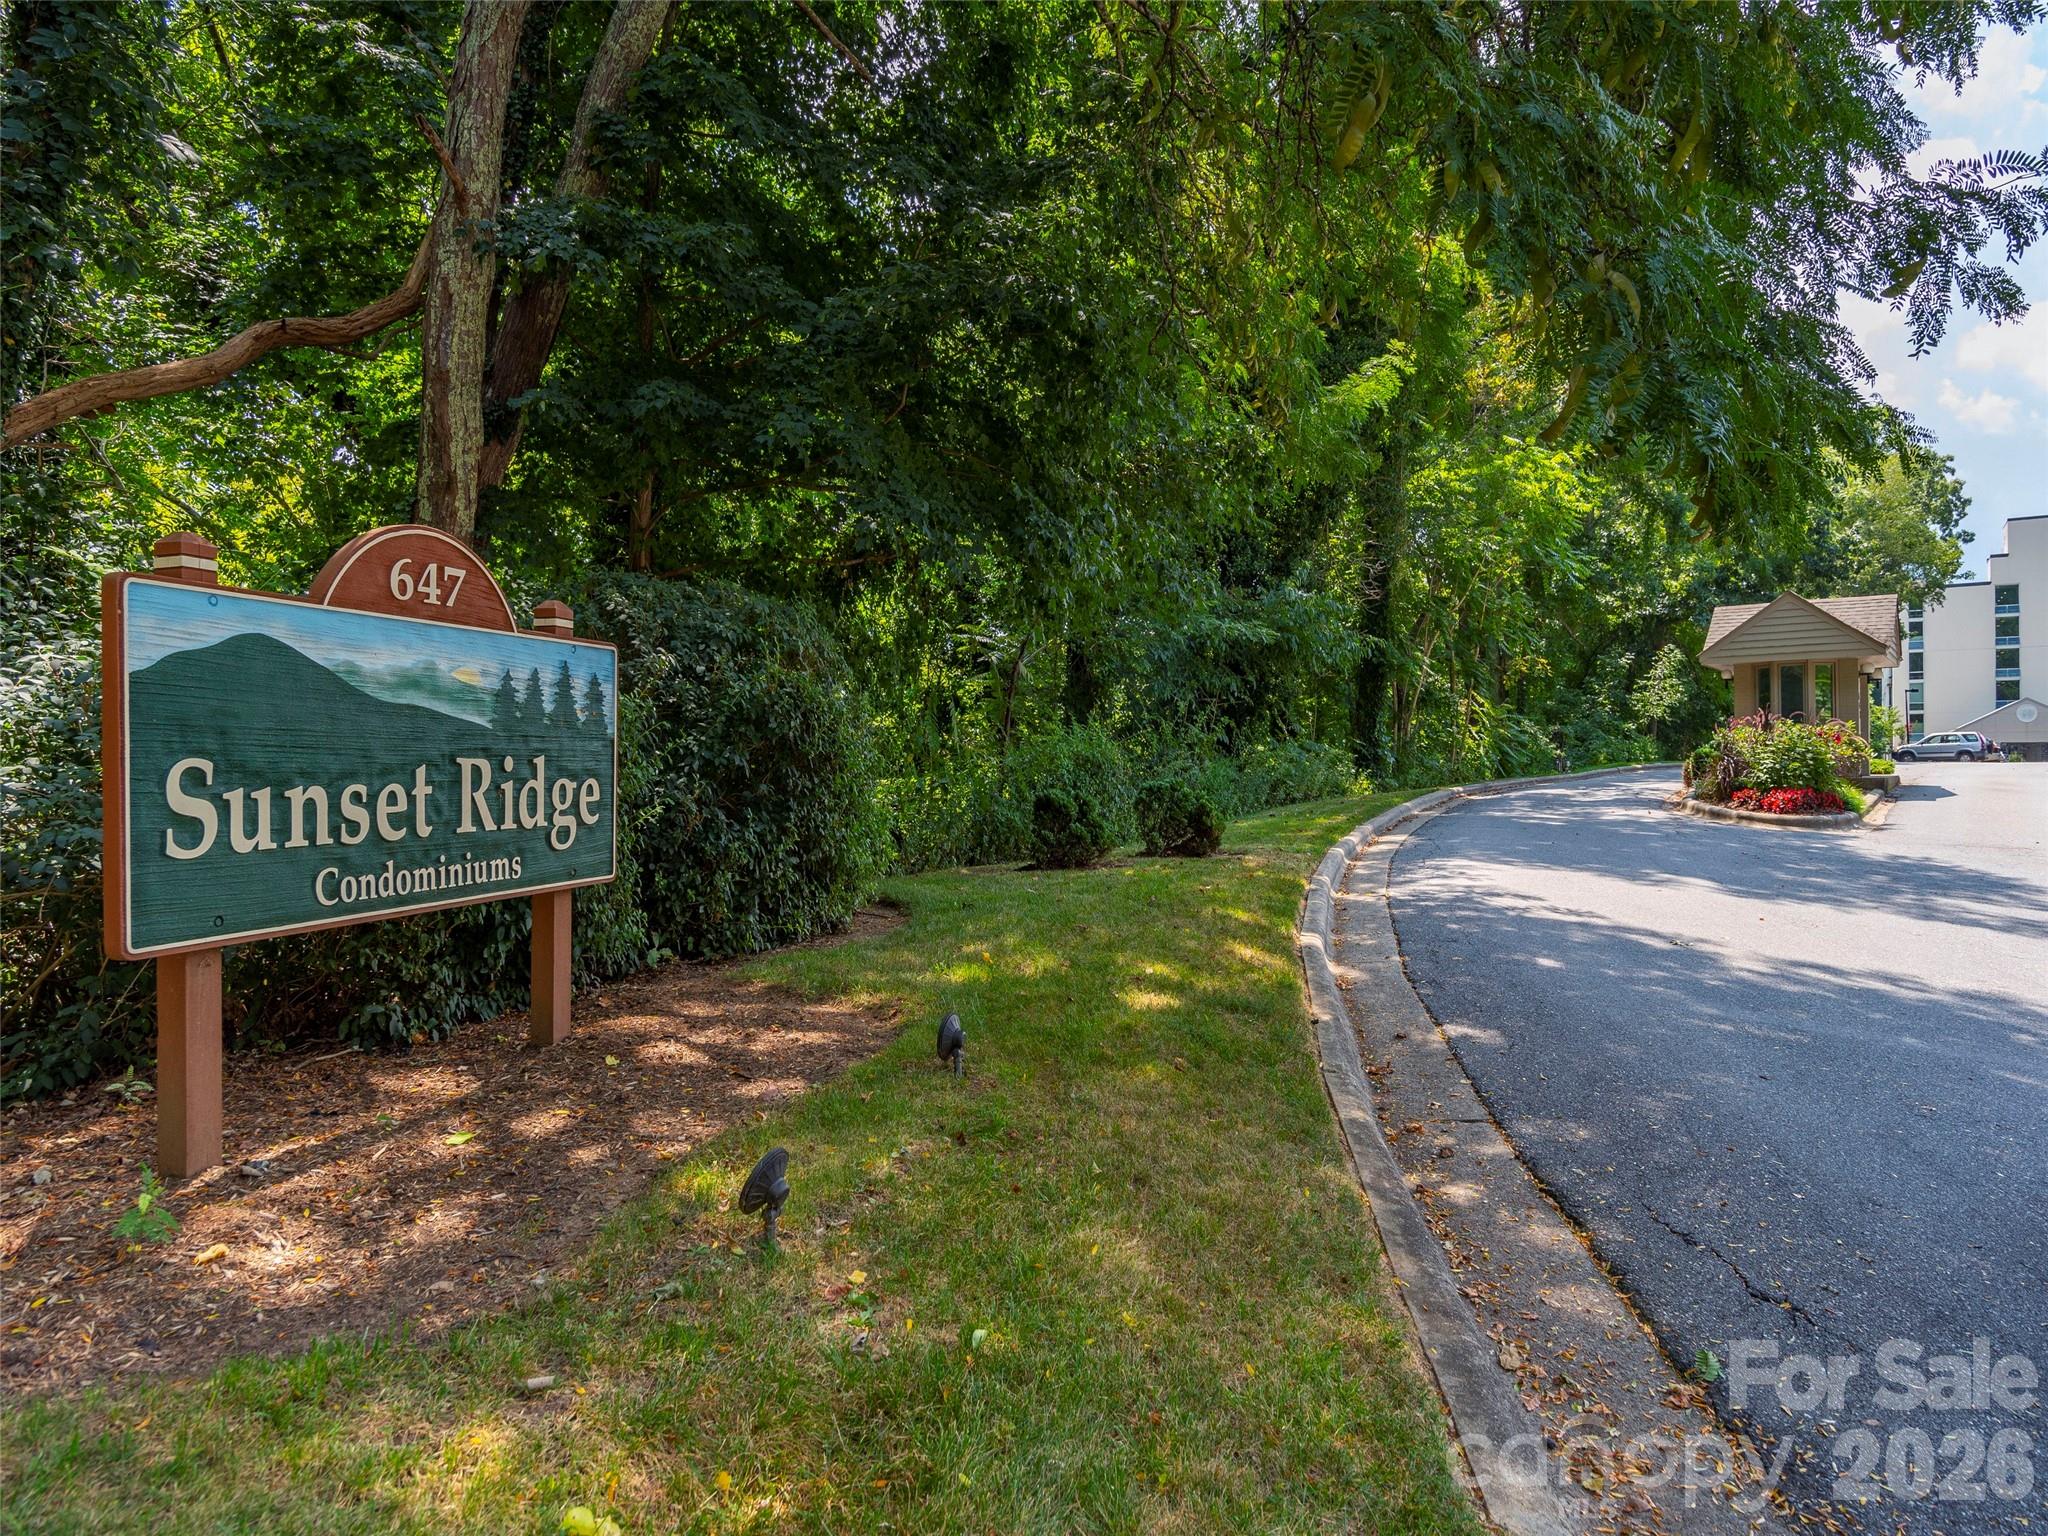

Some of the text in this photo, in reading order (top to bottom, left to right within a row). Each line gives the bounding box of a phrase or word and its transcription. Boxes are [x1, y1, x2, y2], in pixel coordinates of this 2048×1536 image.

[389, 558, 466, 607] 647
[165, 755, 600, 860] Sunset Ridge
[315, 851, 522, 906] Condominiums
